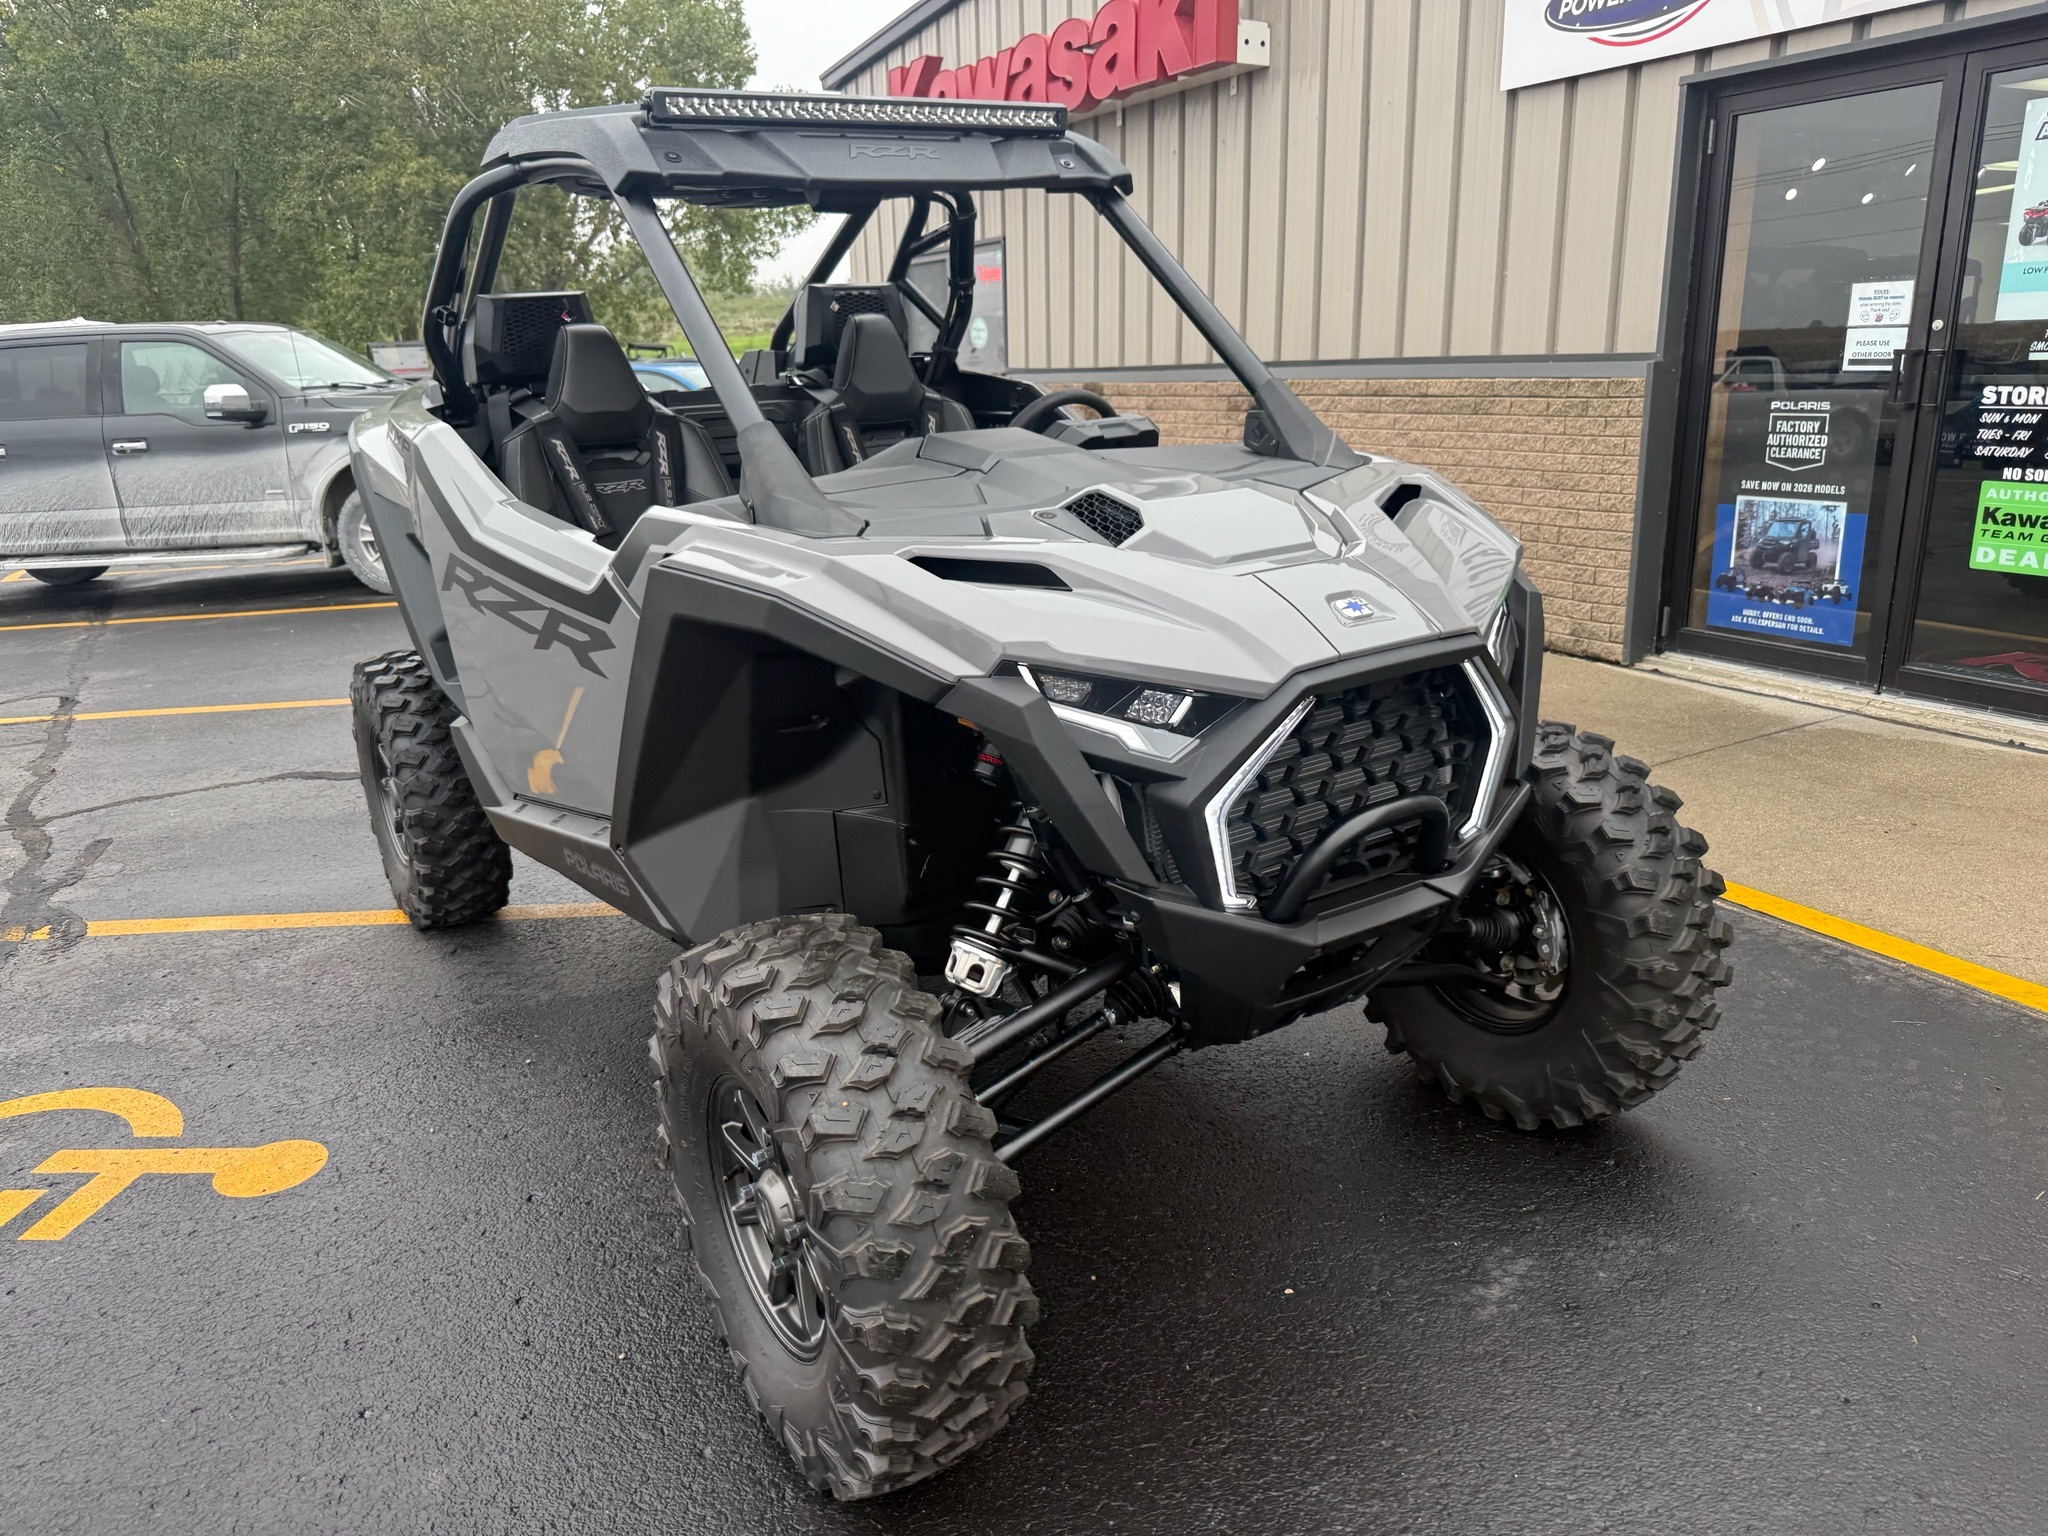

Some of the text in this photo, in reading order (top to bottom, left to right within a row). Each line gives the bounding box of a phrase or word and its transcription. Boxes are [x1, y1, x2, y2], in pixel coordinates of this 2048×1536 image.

[1558, 0, 1633, 19] POW
[849, 143, 941, 160] RZR
[2023, 266, 2043, 275] LOW
[1981, 385, 2048, 405] STOR
[1770, 401, 1831, 410] POLARIS
[1980, 412, 2004, 424] SUN
[2011, 413, 2042, 424] MON
[1776, 420, 1821, 433] FACTORY
[1767, 433, 1828, 448] AUTHORIZED
[1976, 429, 2003, 440] TUES
[2011, 430, 2033, 440] FRI
[655, 430, 669, 476] RZR
[1770, 447, 1821, 460] CLEARANCE
[1974, 445, 2034, 458] SATURDAY
[551, 438, 580, 481] RZR
[2003, 467, 2022, 480] NO
[1741, 480, 1760, 490] SAVE
[1761, 481, 1780, 491] NOW
[1781, 482, 1792, 492] ON
[1814, 484, 1846, 495] MODELS
[1981, 528, 2034, 541] TEAM
[441, 552, 617, 681] RZR
[1731, 615, 1742, 623] ASK
[1748, 616, 1786, 630] SALESPERSON
[1786, 622, 1798, 631] FOR
[1762, 610, 1784, 620] OFFERS
[1784, 613, 1796, 622] END
[563, 847, 631, 897] POLARIS
